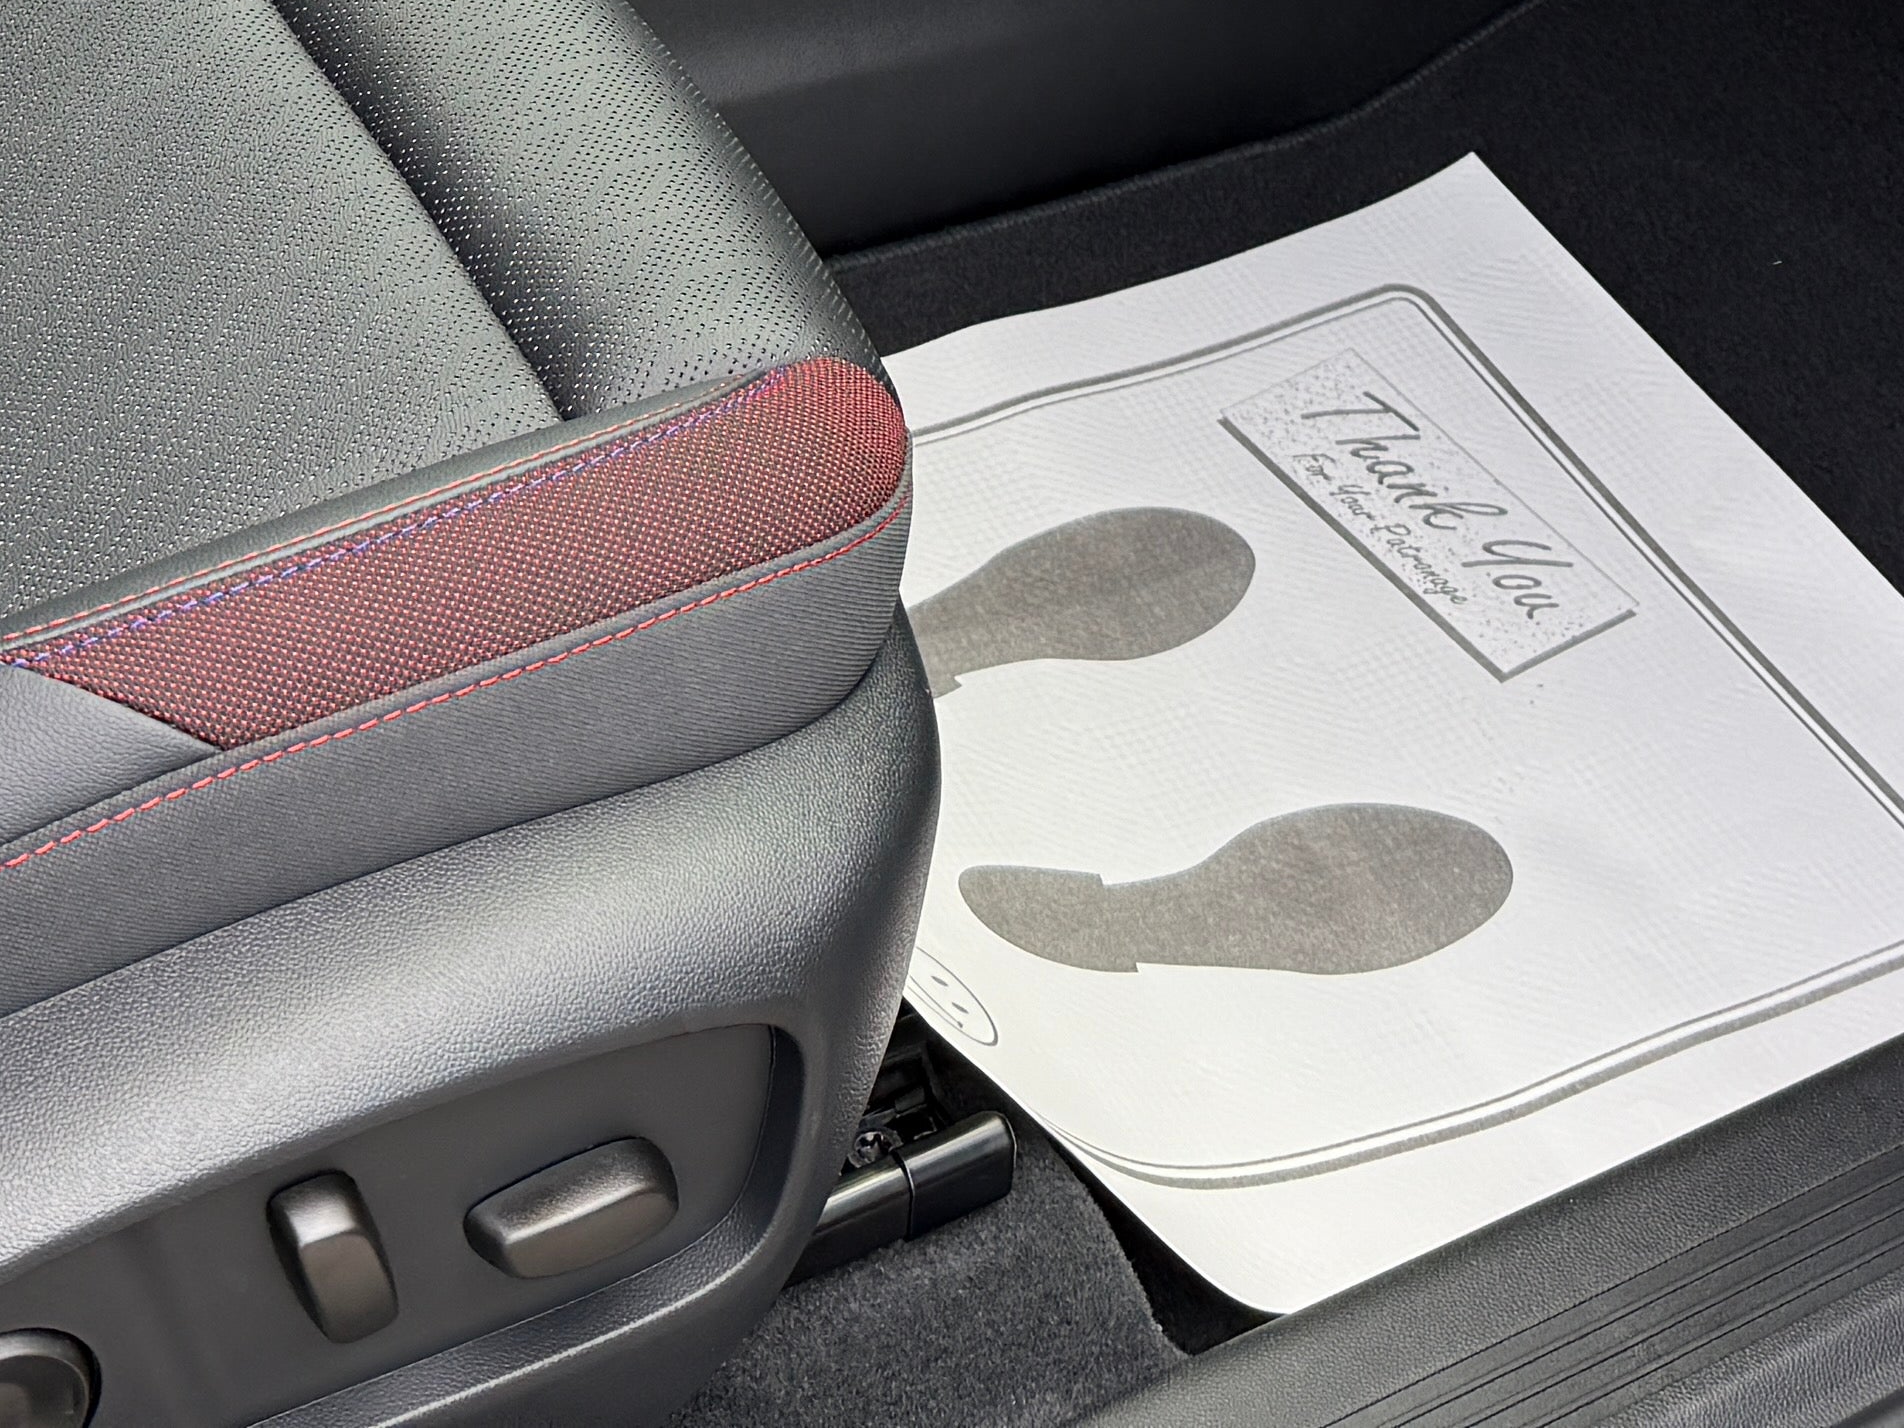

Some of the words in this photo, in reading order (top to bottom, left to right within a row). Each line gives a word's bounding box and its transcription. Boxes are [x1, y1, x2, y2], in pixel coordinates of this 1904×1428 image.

[1292, 451, 1333, 483] For
[1371, 523, 1470, 607] Patronage
[1301, 391, 1508, 532] Thank
[1461, 539, 1574, 620] You
